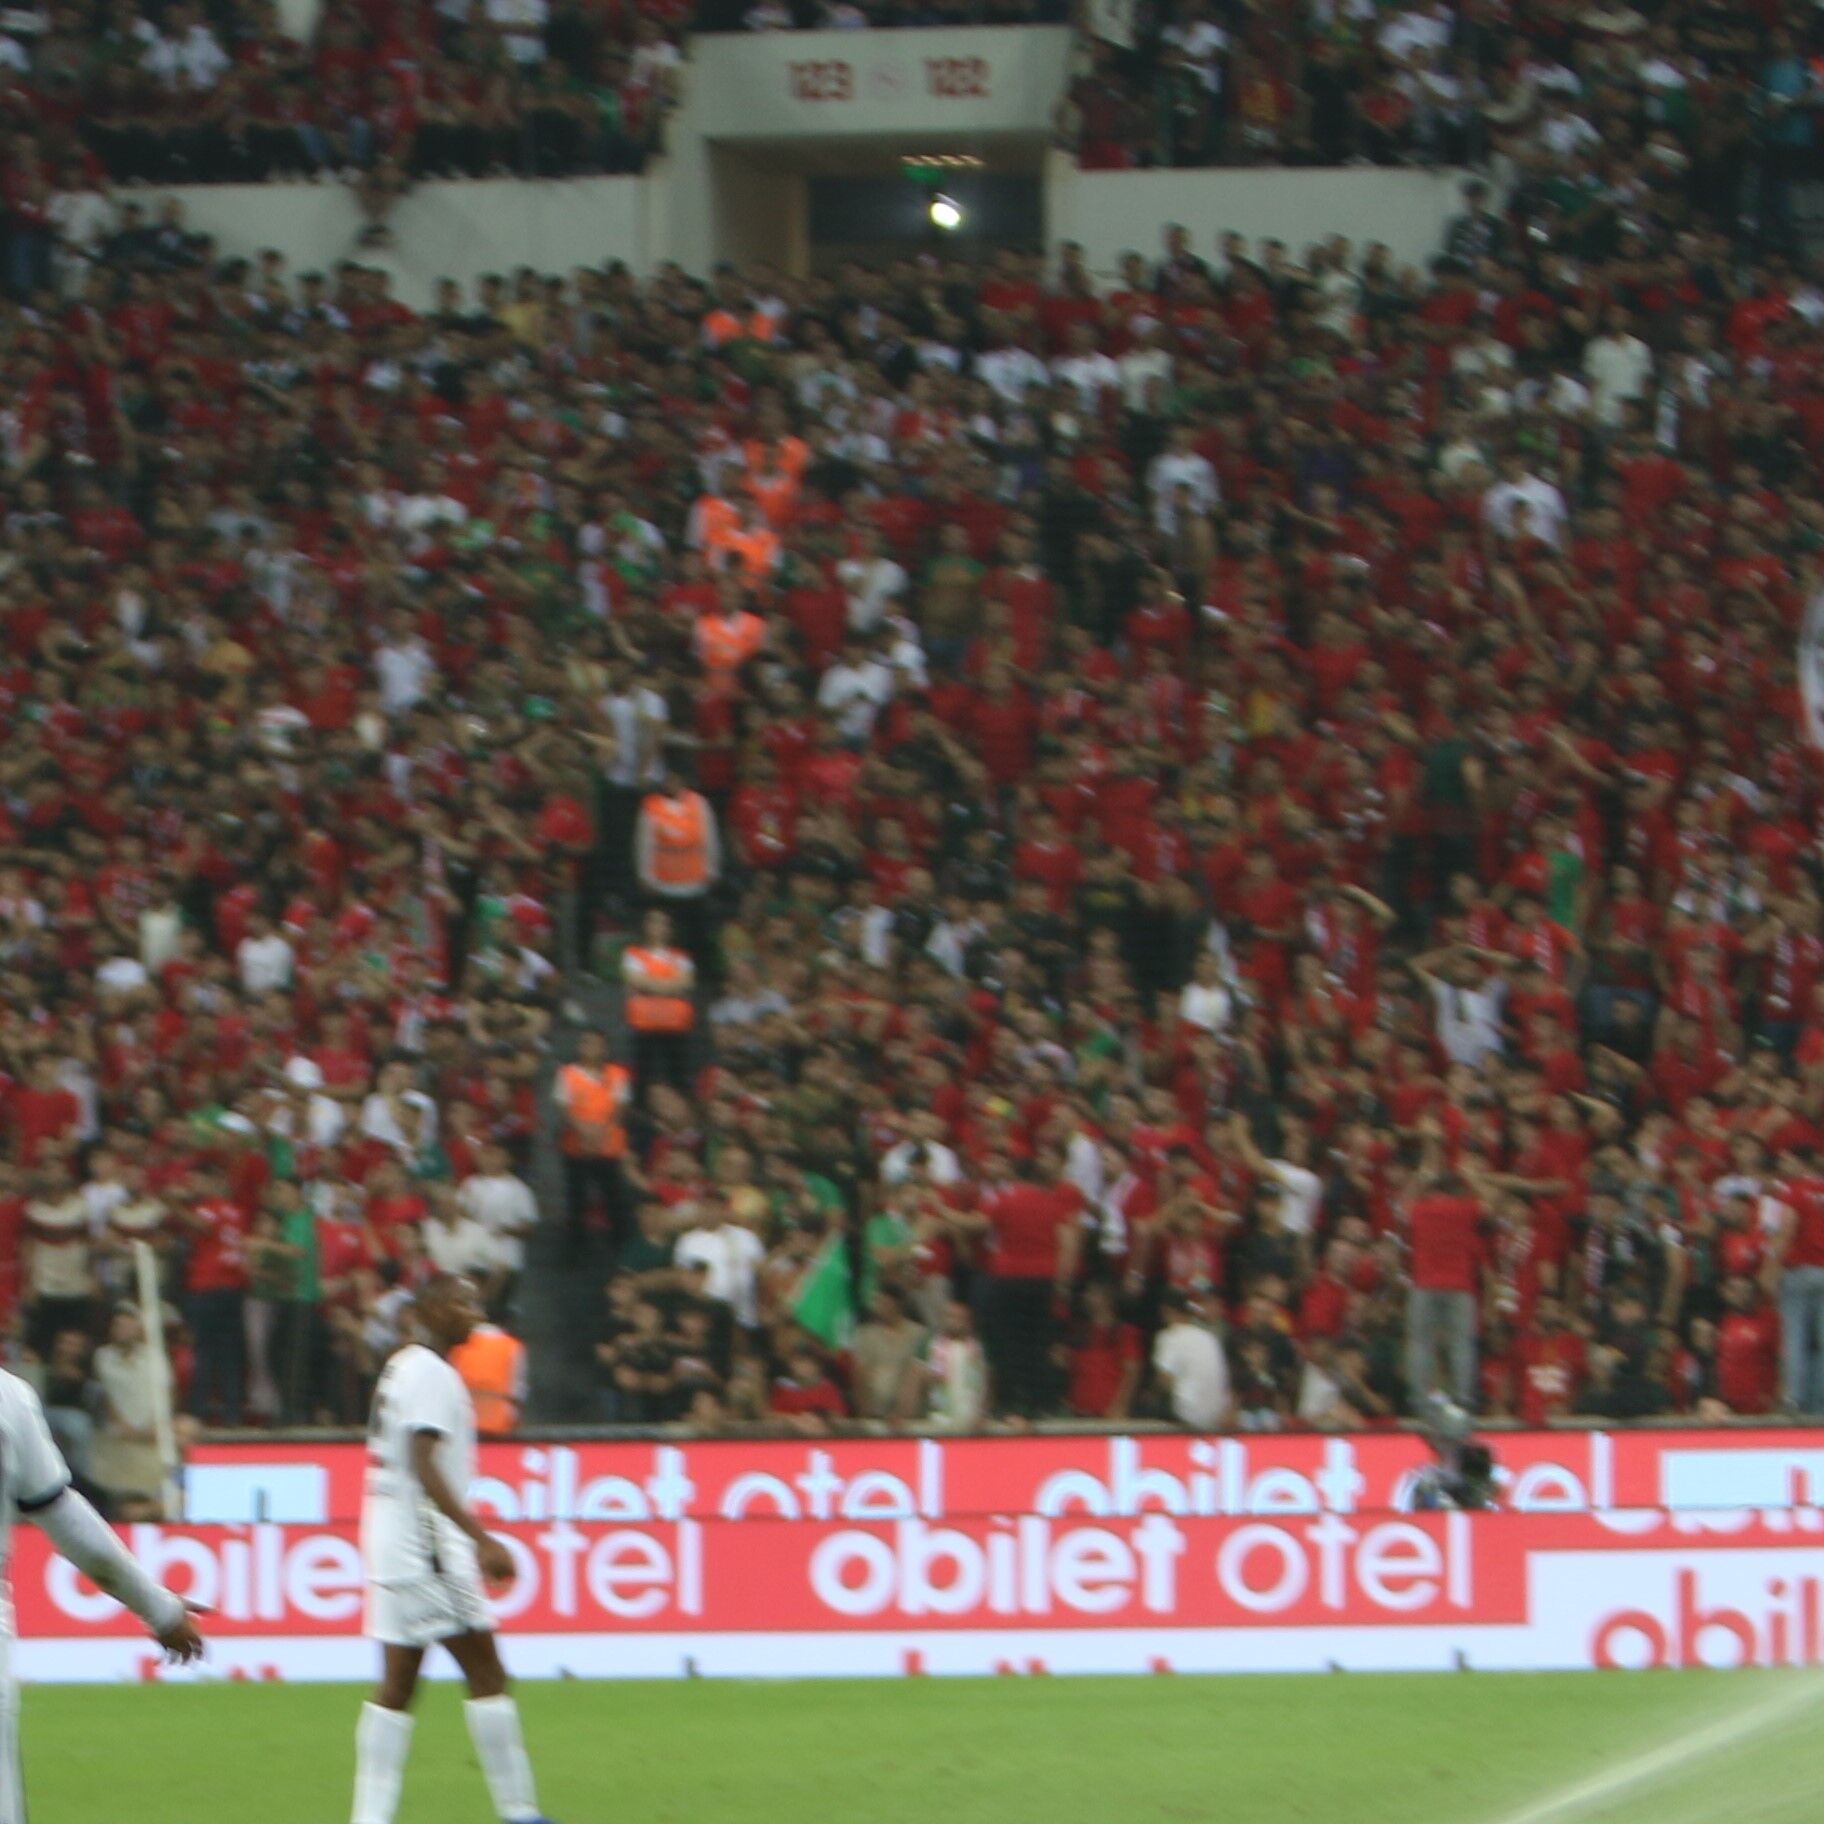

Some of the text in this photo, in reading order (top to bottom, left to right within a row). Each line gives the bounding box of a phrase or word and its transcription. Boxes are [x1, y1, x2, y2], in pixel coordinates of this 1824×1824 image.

[44, 1521, 363, 1622] obile
[809, 1512, 1474, 1615] obilet otel
